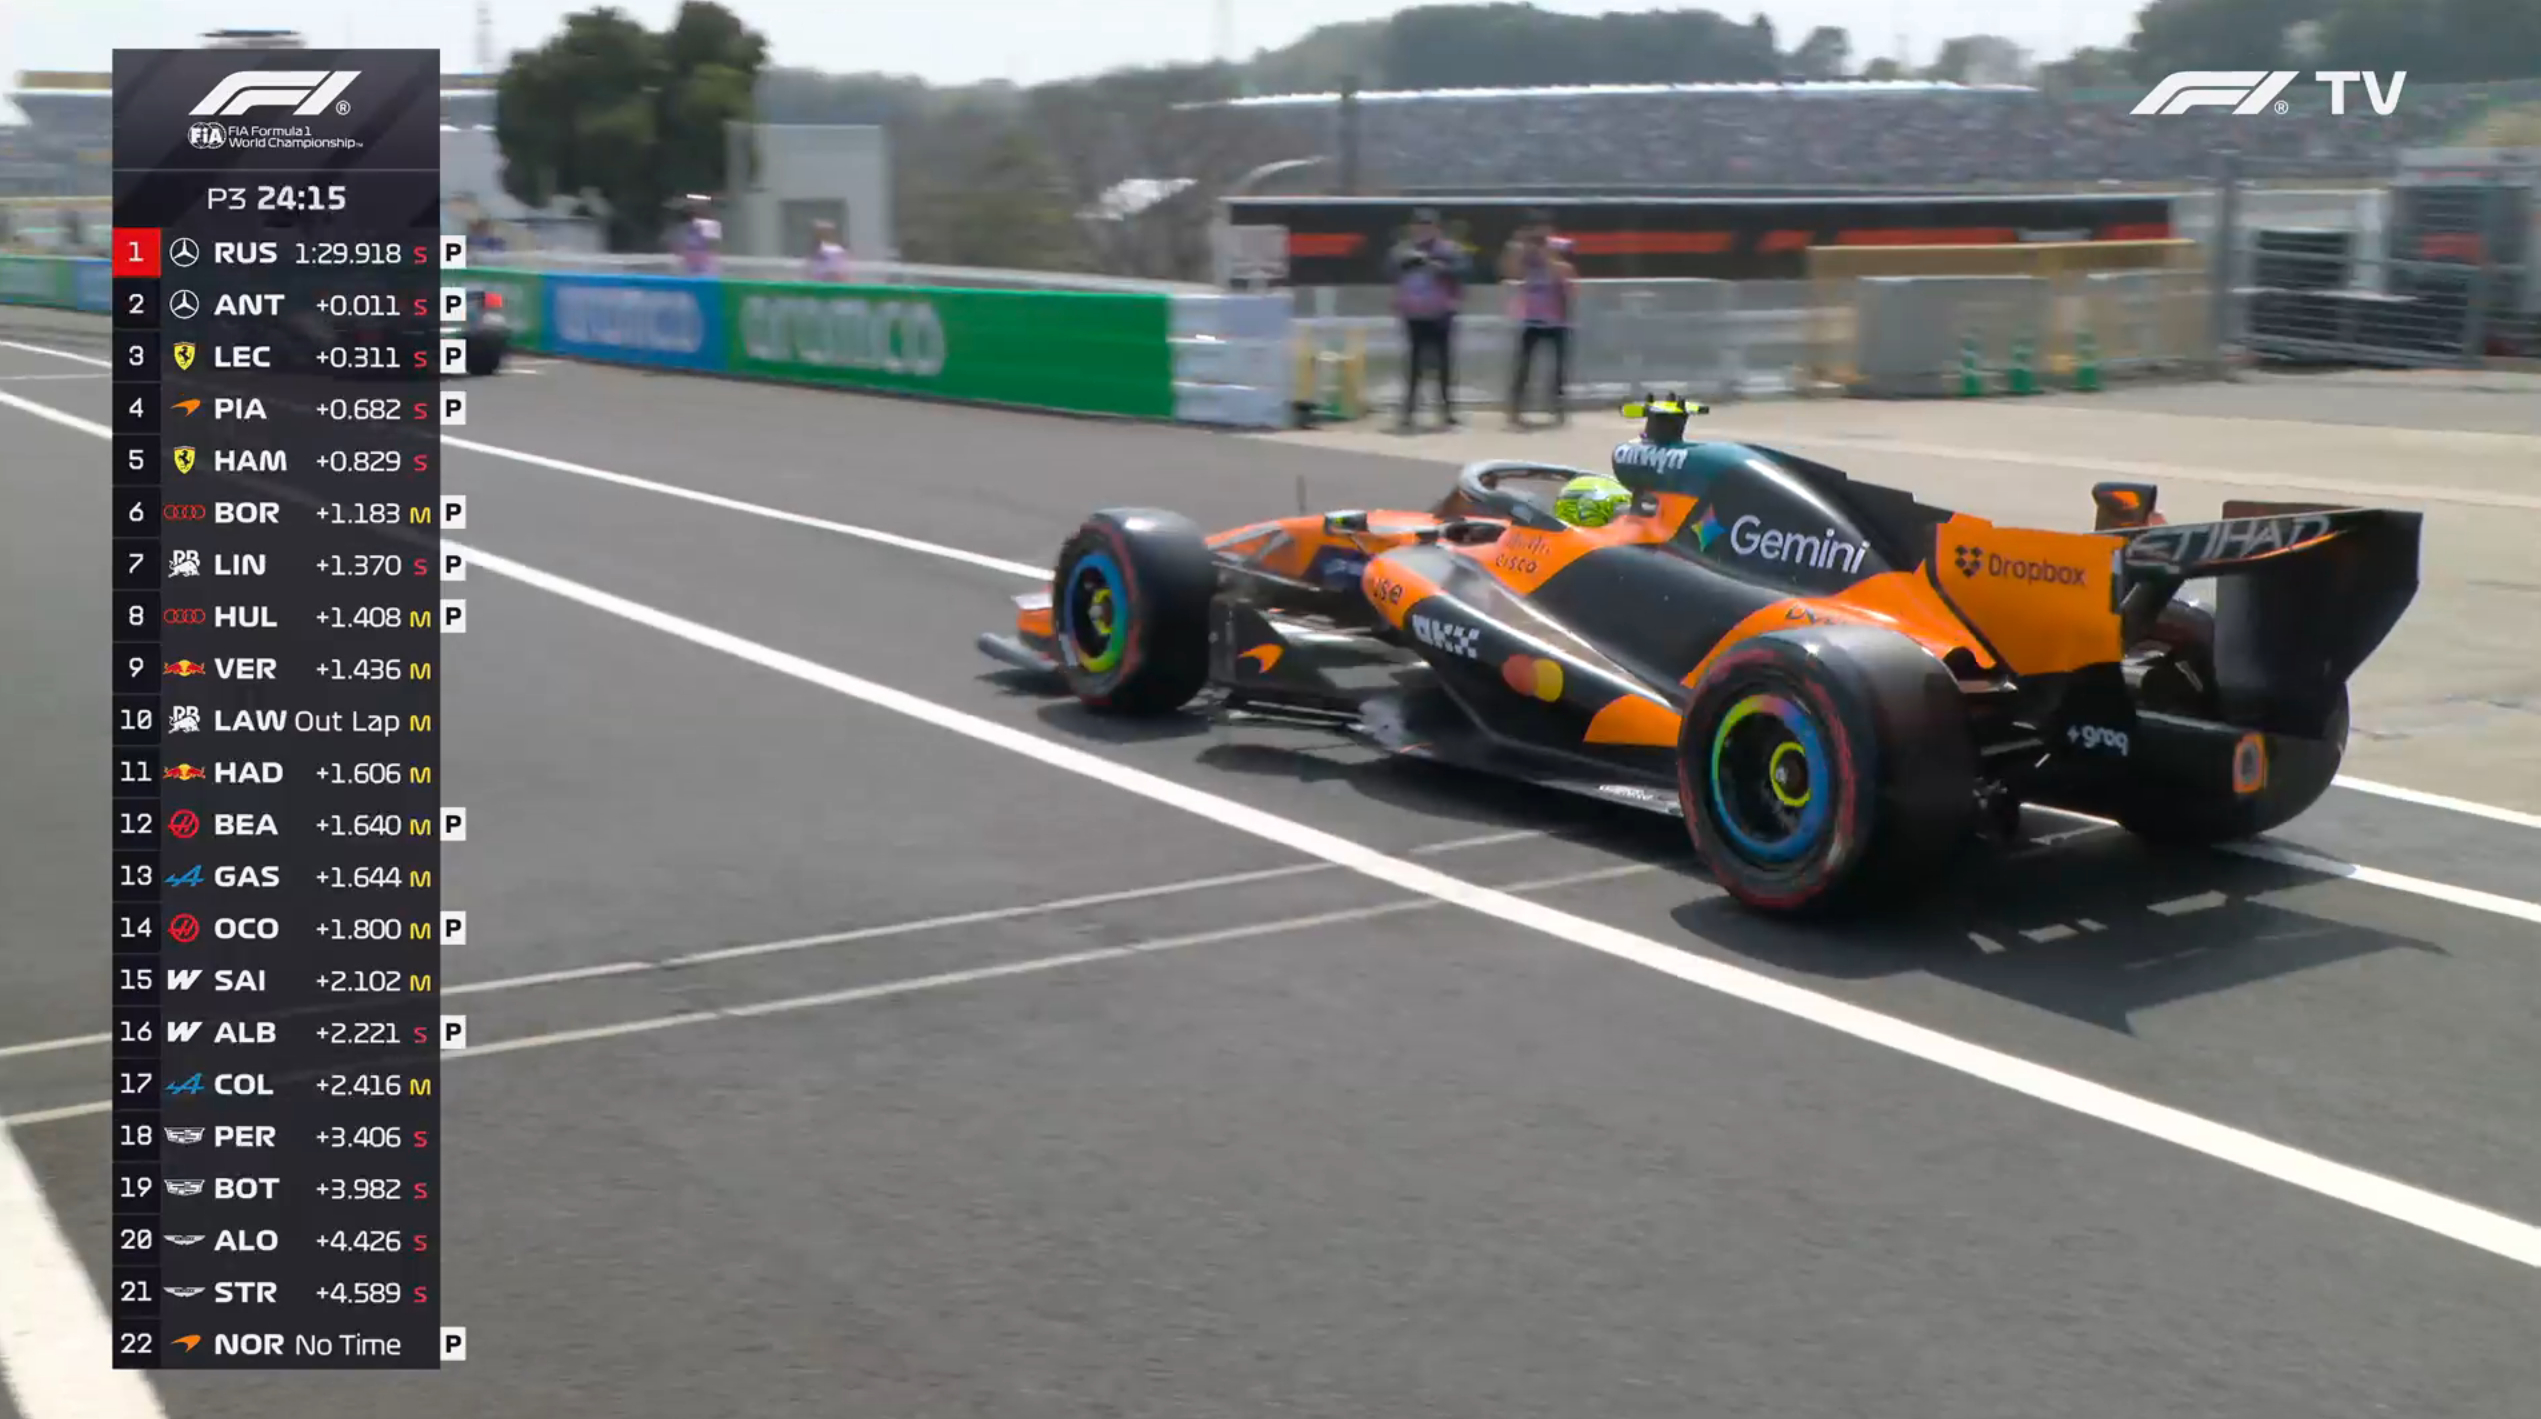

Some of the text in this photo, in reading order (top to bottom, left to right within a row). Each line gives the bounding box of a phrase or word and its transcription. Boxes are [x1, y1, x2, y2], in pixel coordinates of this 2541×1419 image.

[1731, 514, 1871, 574] Gemini
[2127, 515, 2331, 562] ETIHAD
[1988, 552, 2088, 586] Dropbox
